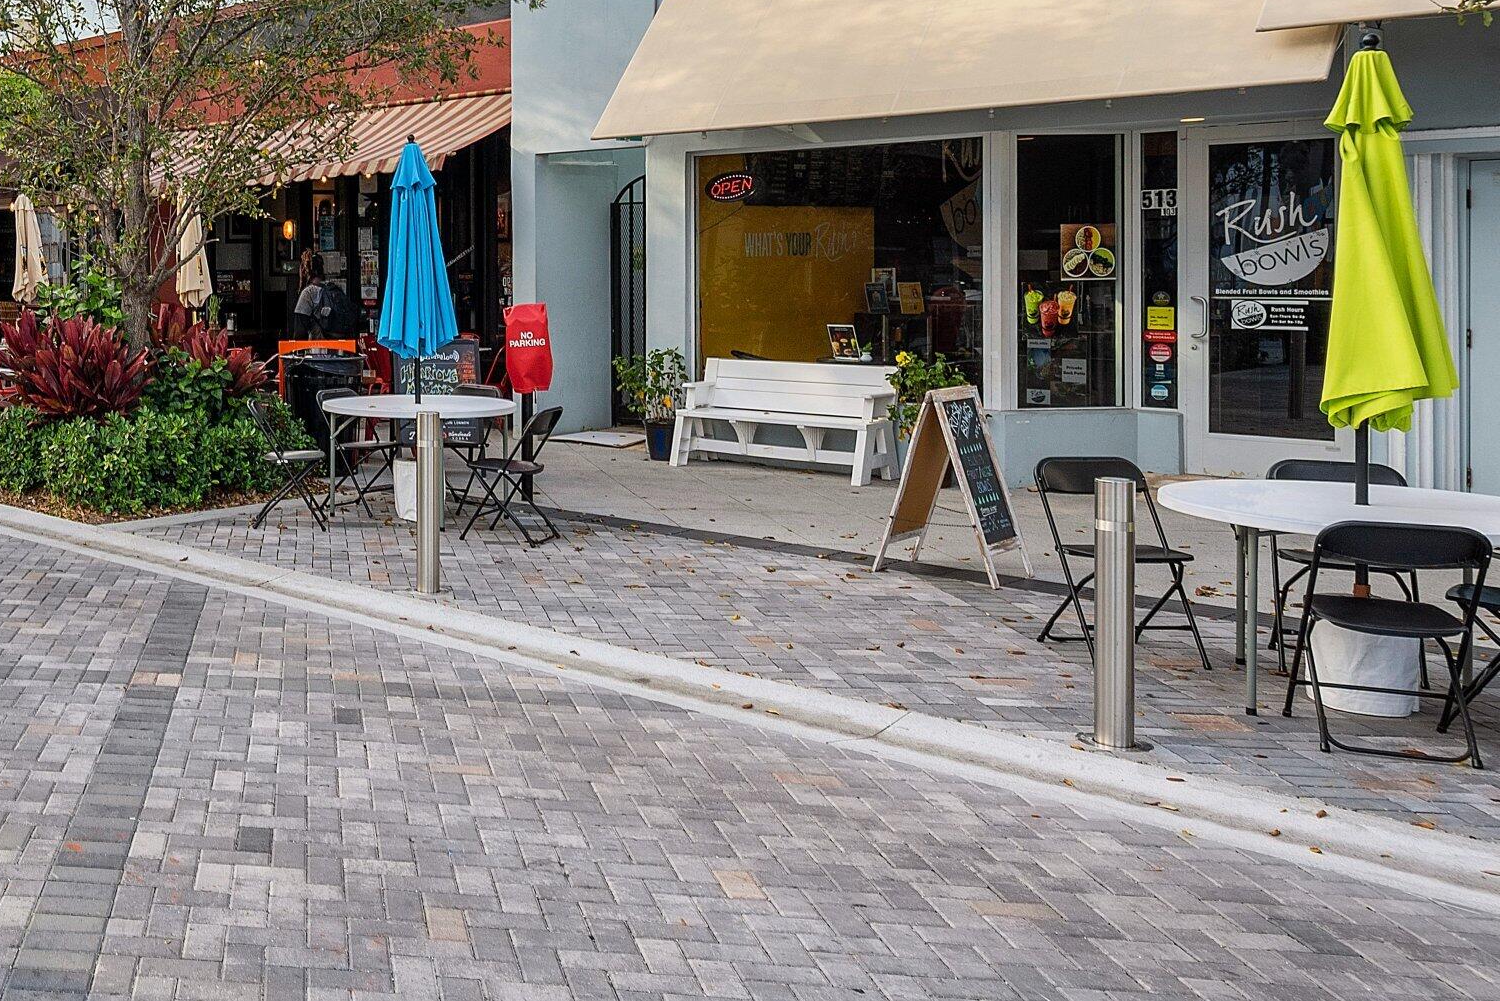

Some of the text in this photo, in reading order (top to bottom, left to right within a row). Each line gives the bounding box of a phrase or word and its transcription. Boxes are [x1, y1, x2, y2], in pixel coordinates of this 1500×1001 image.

[711, 178, 753, 196] OPEN
[1142, 190, 1177, 208] 513
[1215, 190, 1318, 246] Rush
[744, 231, 784, 257] WHAT'S
[785, 231, 812, 257] YOUR
[1235, 236, 1325, 277] bowls
[1236, 304, 1262, 317] Rush
[509, 338, 546, 348] PARKING
[520, 331, 534, 340] NO
